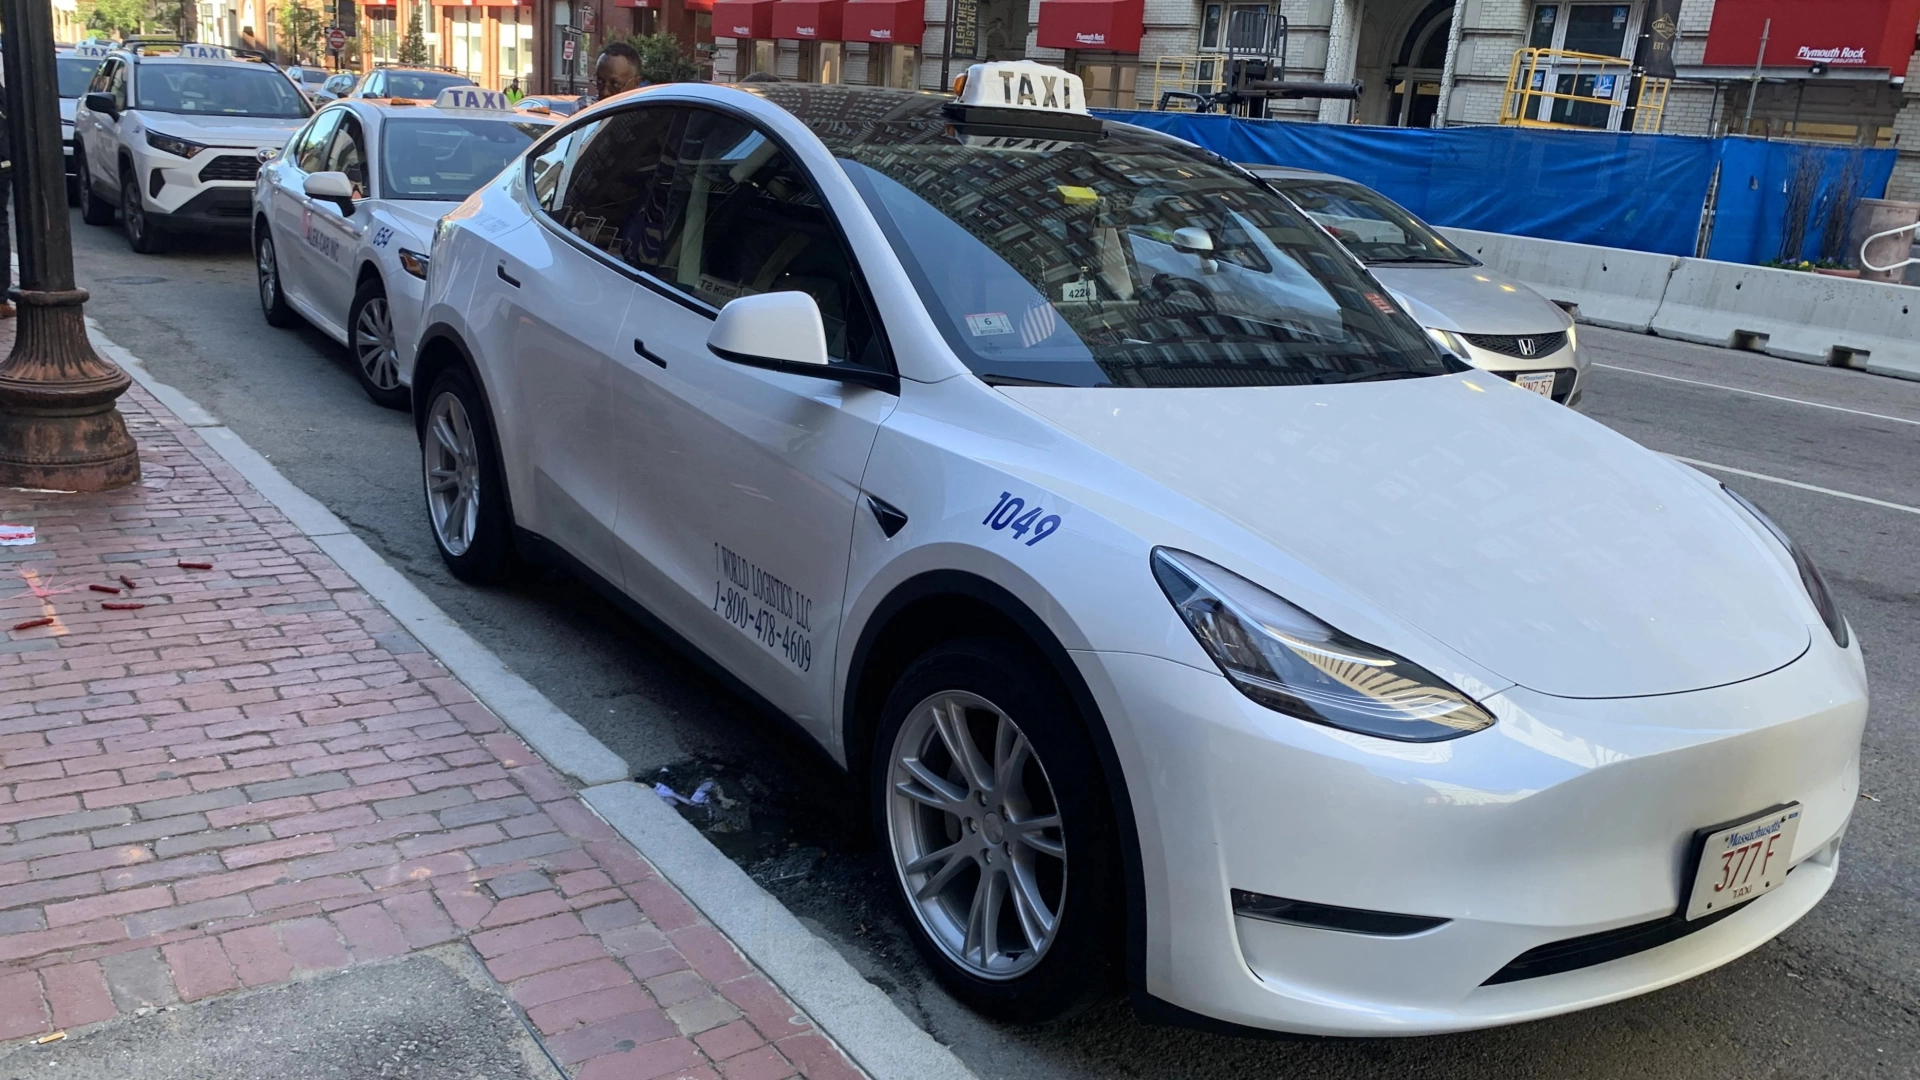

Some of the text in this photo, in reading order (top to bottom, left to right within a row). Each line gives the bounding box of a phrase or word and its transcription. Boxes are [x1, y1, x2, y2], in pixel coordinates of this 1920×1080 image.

[82, 47, 112, 57] TAX
[187, 46, 226, 59] TAXI
[1797, 46, 1866, 58] Plymouth Rock
[448, 90, 506, 110] TAXI
[998, 71, 1071, 109] TAXI
[373, 227, 394, 249] 654
[1068, 288, 1091, 299] 4228
[984, 317, 992, 325] 6
[982, 491, 1061, 547] 1049
[722, 546, 749, 591] WORLD
[752, 564, 793, 620] LOGISTICS
[796, 591, 812, 633] LLC
[713, 580, 811, 672] 1-800-478-4609
[1728, 820, 1781, 848] Massachusetts
[1733, 884, 1752, 899] TAXI
